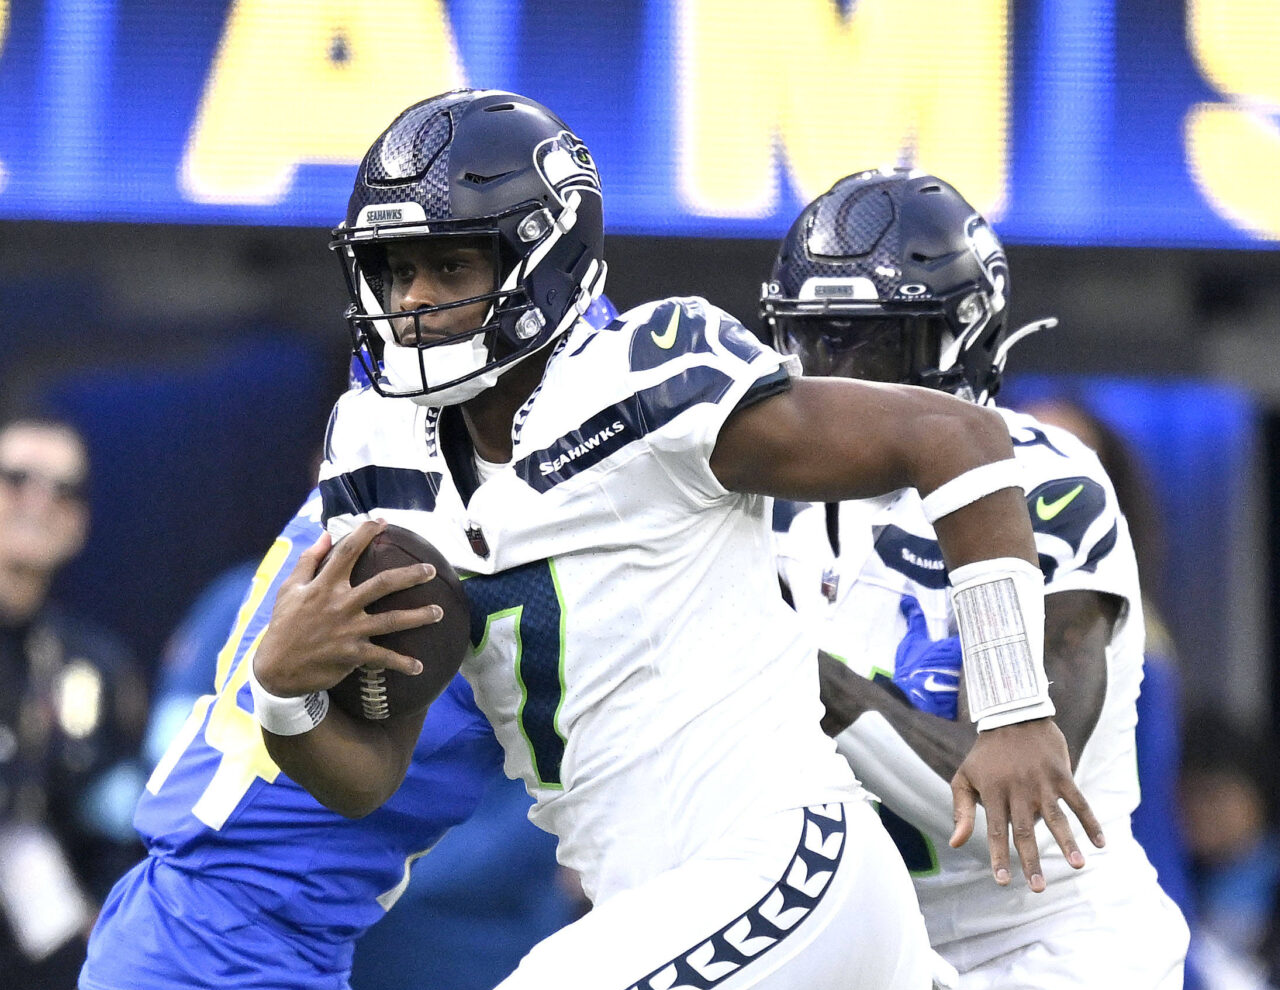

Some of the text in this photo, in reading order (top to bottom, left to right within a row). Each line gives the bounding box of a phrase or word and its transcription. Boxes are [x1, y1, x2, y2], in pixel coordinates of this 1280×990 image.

[366, 209, 403, 221] SEAHAWKS
[539, 421, 625, 476] SEAHAWKS
[456, 557, 567, 790] 7
